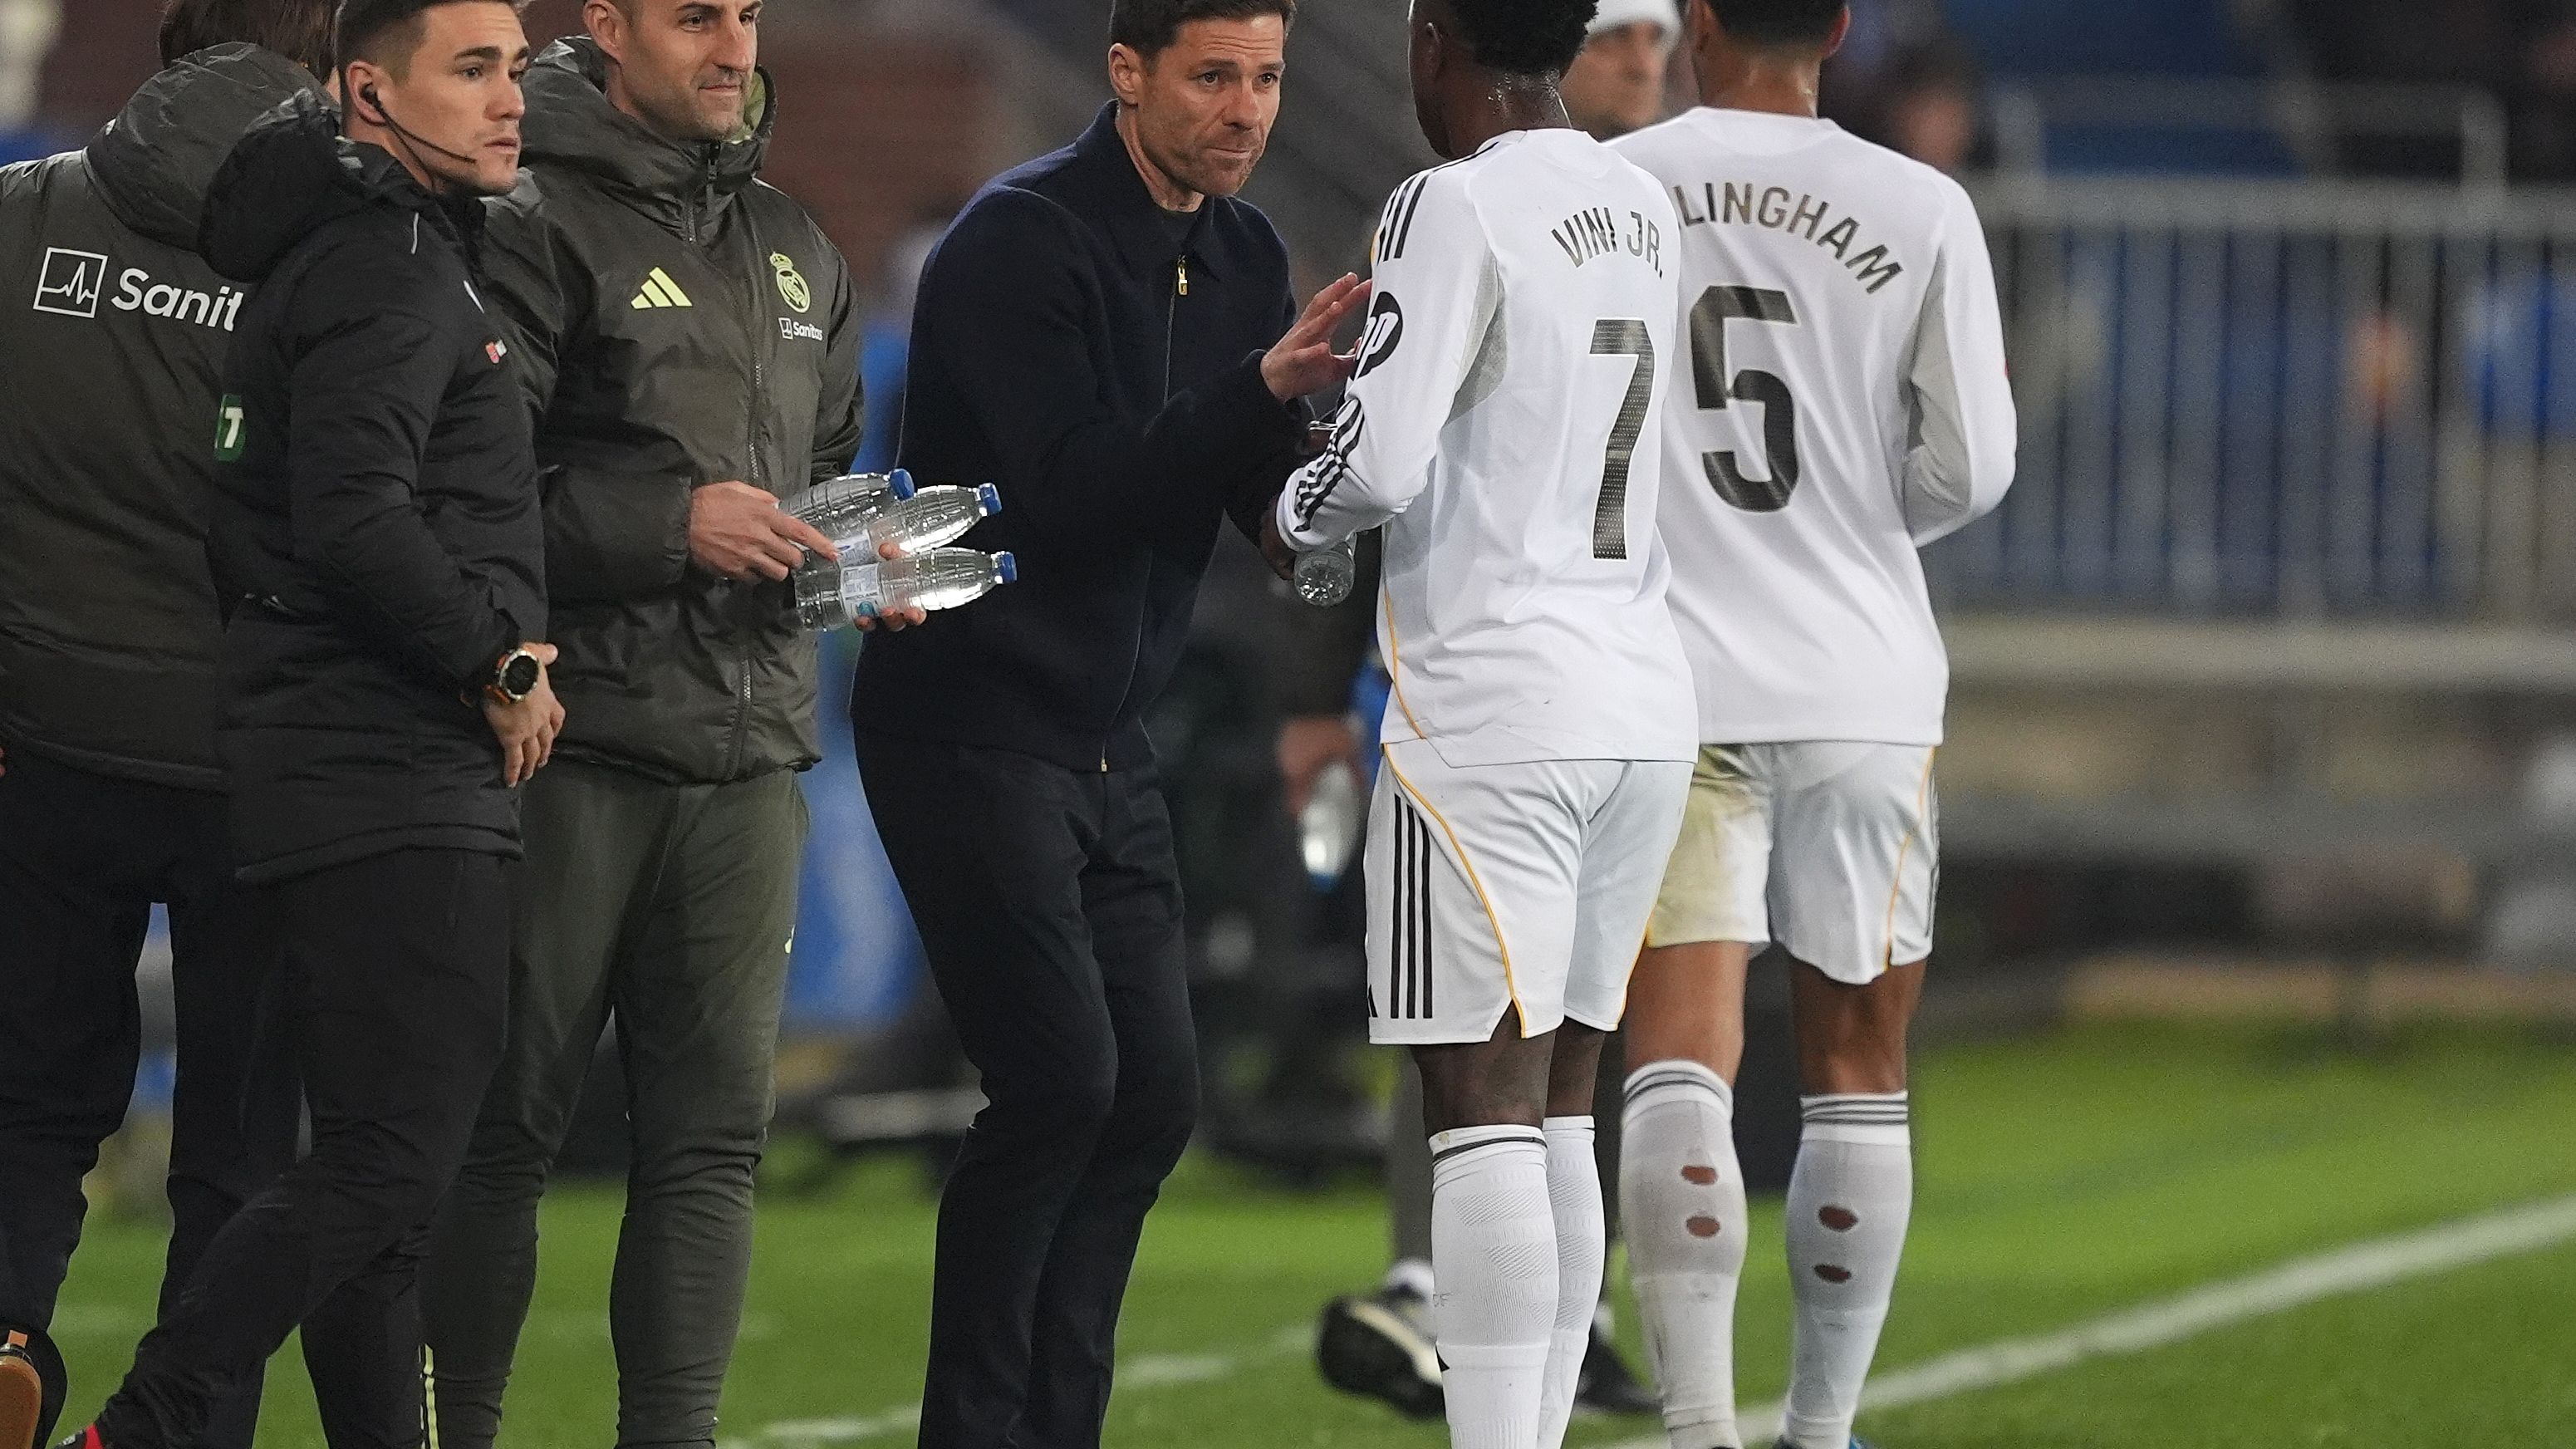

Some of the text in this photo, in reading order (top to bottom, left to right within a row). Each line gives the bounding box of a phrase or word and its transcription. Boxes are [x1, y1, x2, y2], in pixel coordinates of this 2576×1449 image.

[1551, 207, 1662, 280] VINI JR.
[1673, 182, 1902, 295] LINGHAM
[792, 321, 823, 341] Sanitas
[1589, 318, 1656, 560] 7
[1689, 285, 1799, 513] 5
